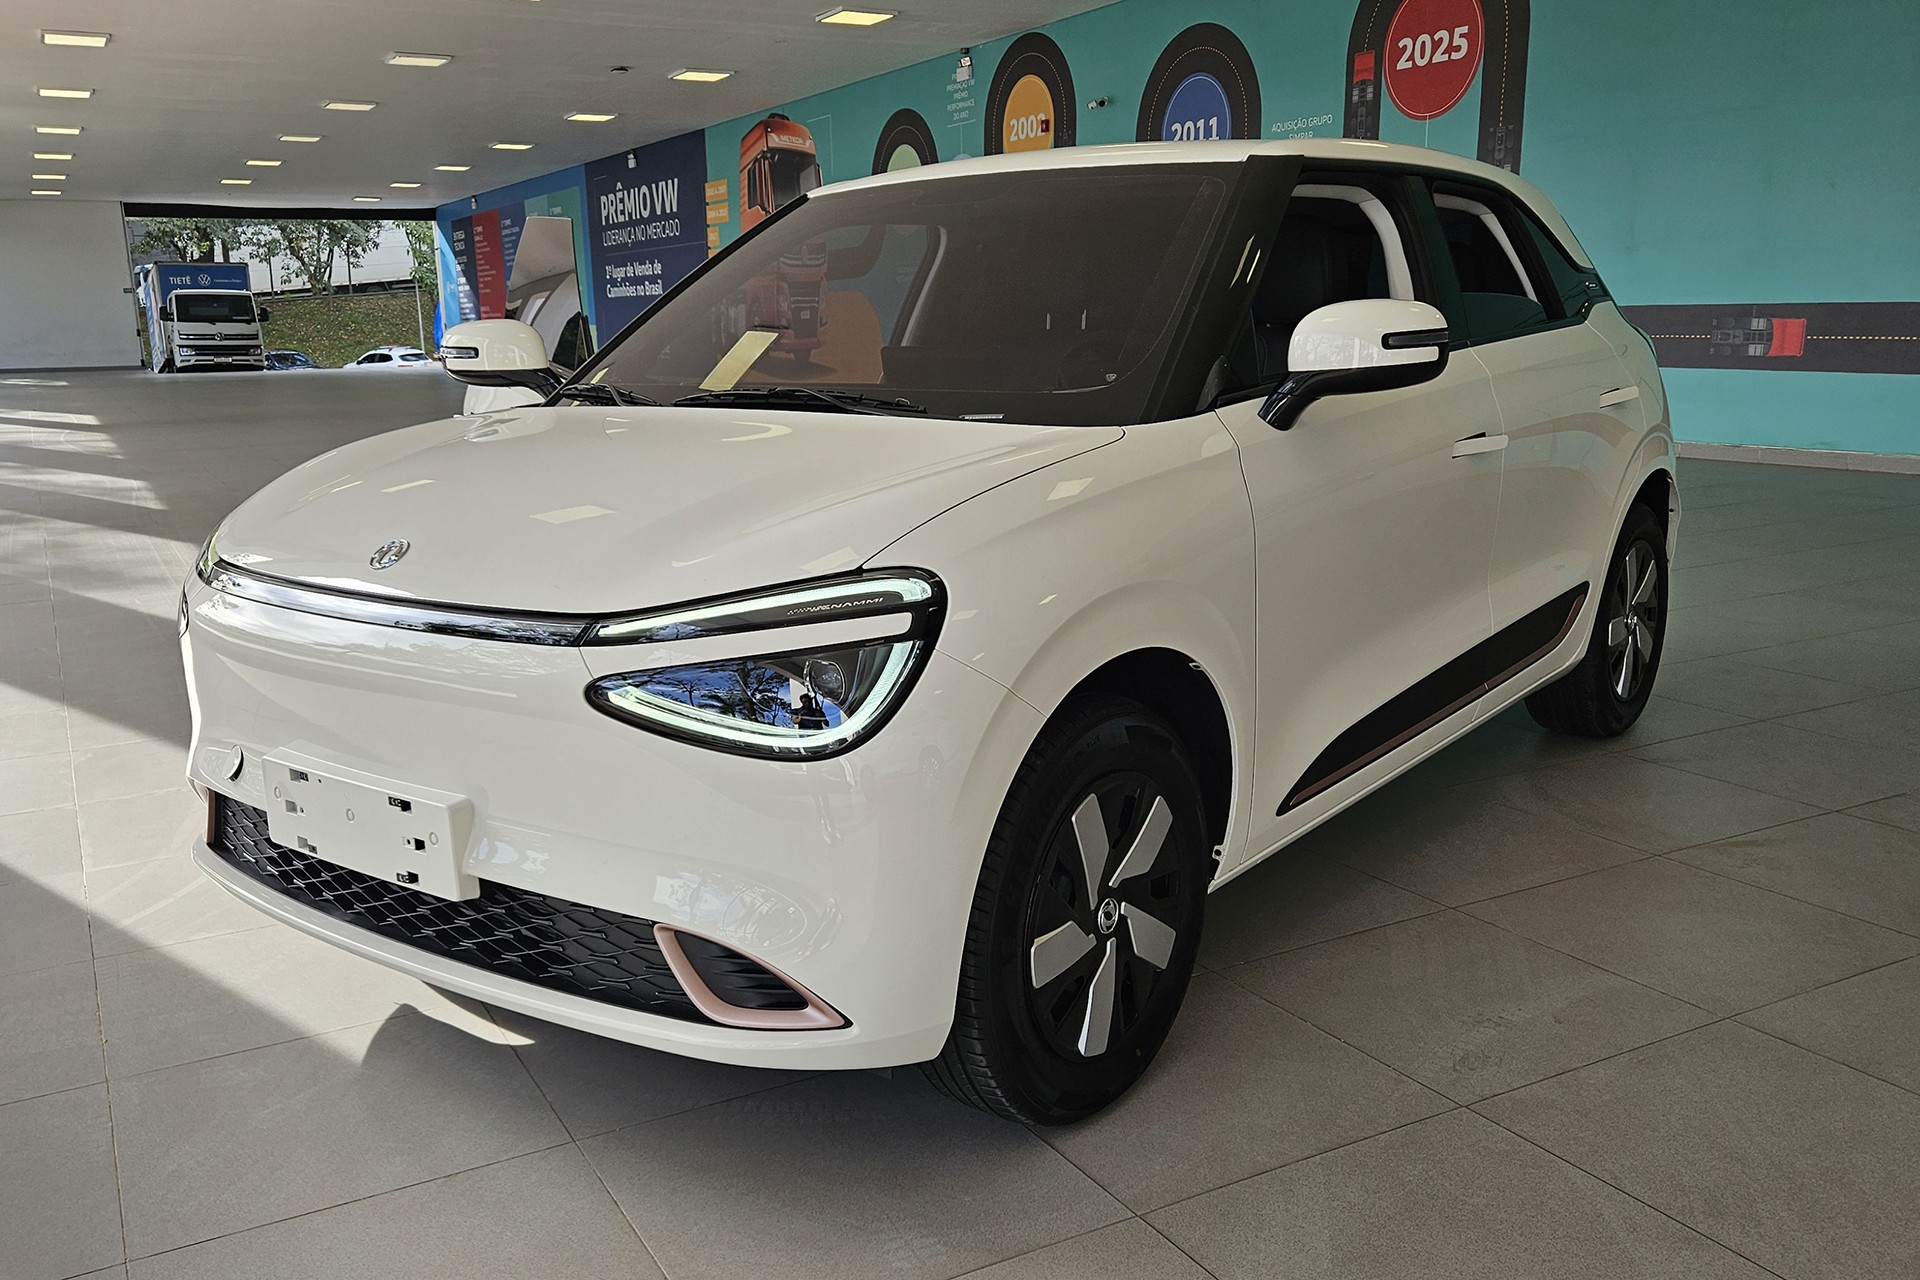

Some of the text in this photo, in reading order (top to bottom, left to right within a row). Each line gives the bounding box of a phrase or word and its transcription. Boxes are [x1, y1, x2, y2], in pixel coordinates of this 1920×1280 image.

[1396, 25, 1469, 70] 2025
[1171, 116, 1220, 141] 2011
[1271, 113, 1333, 132] AQUISIÇÃO GRUPO
[600, 177, 678, 225] PRÊMIO VW
[602, 218, 681, 247] LIDERANÇA NO MERCADO
[169, 276, 191, 284] TIETÊ
[612, 263, 626, 281] lugar
[626, 262, 634, 277] de
[634, 259, 653, 276] Venda
[653, 258, 662, 274] de
[606, 279, 663, 298] Caminhões no Brasil
